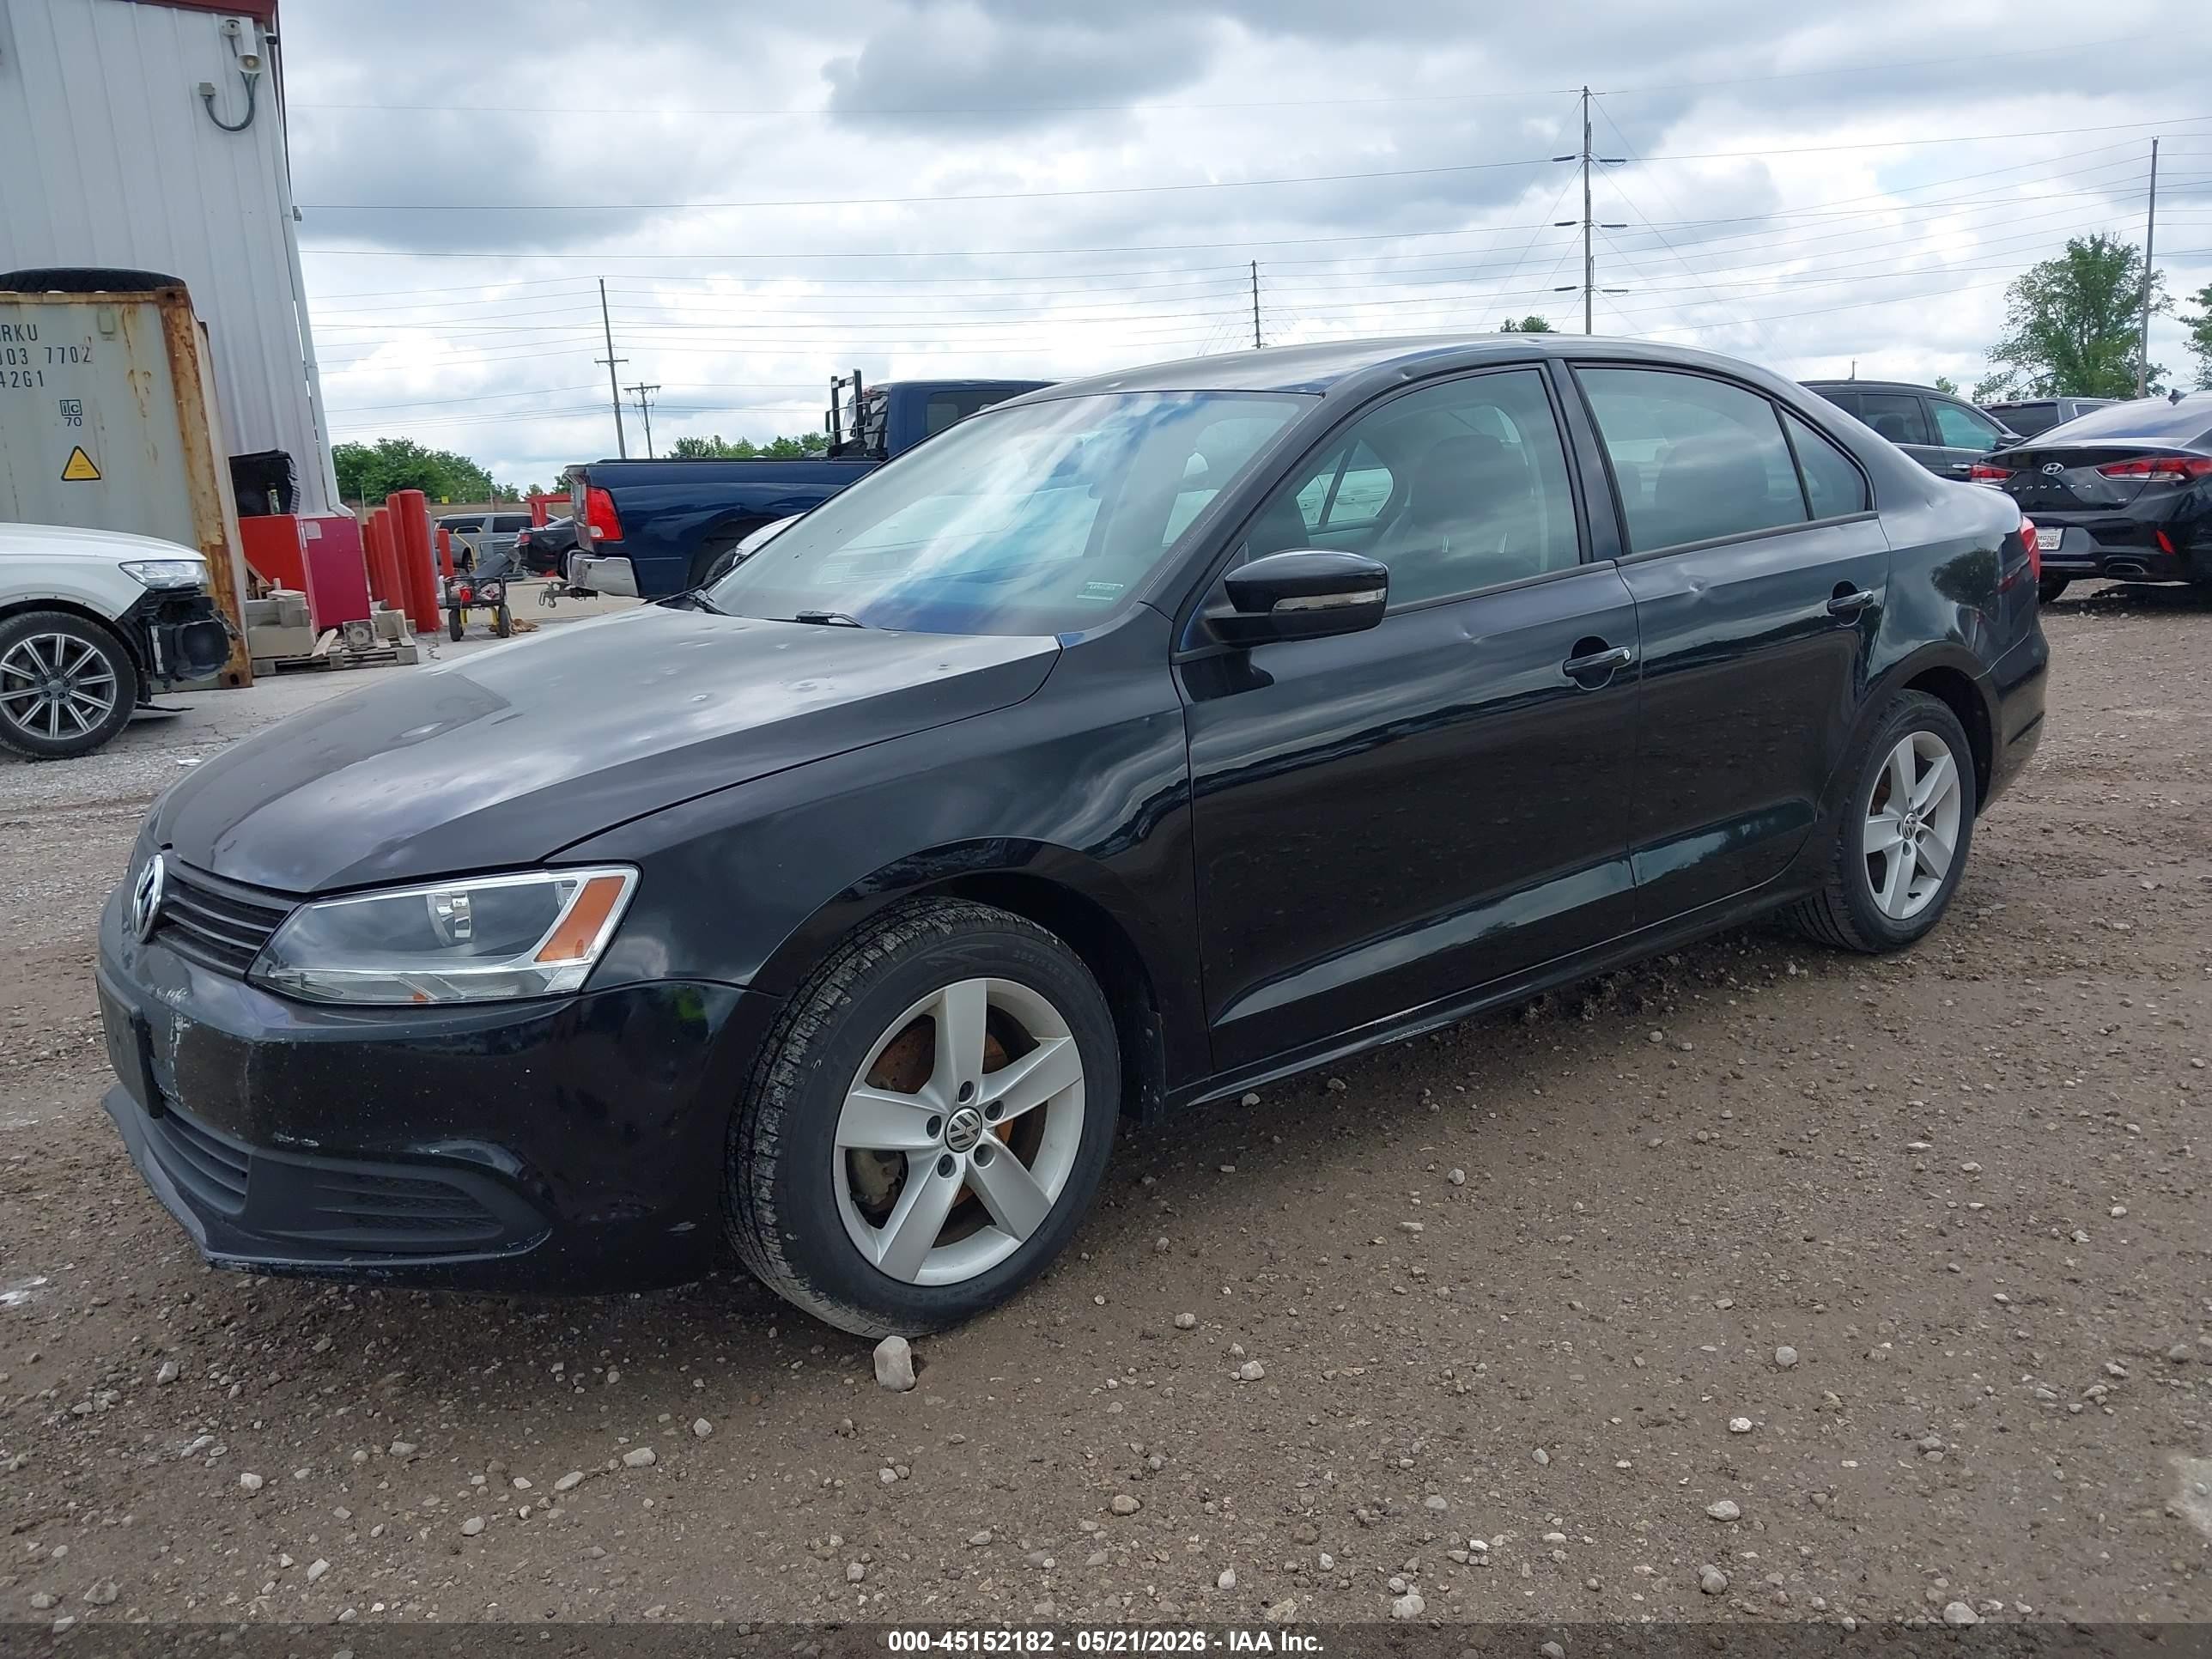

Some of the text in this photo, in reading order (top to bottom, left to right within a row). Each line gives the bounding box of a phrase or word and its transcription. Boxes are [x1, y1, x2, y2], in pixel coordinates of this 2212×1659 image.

[0, 324, 38, 342] RKU
[43, 346, 92, 364] 7702
[64, 416, 82, 427] 70
